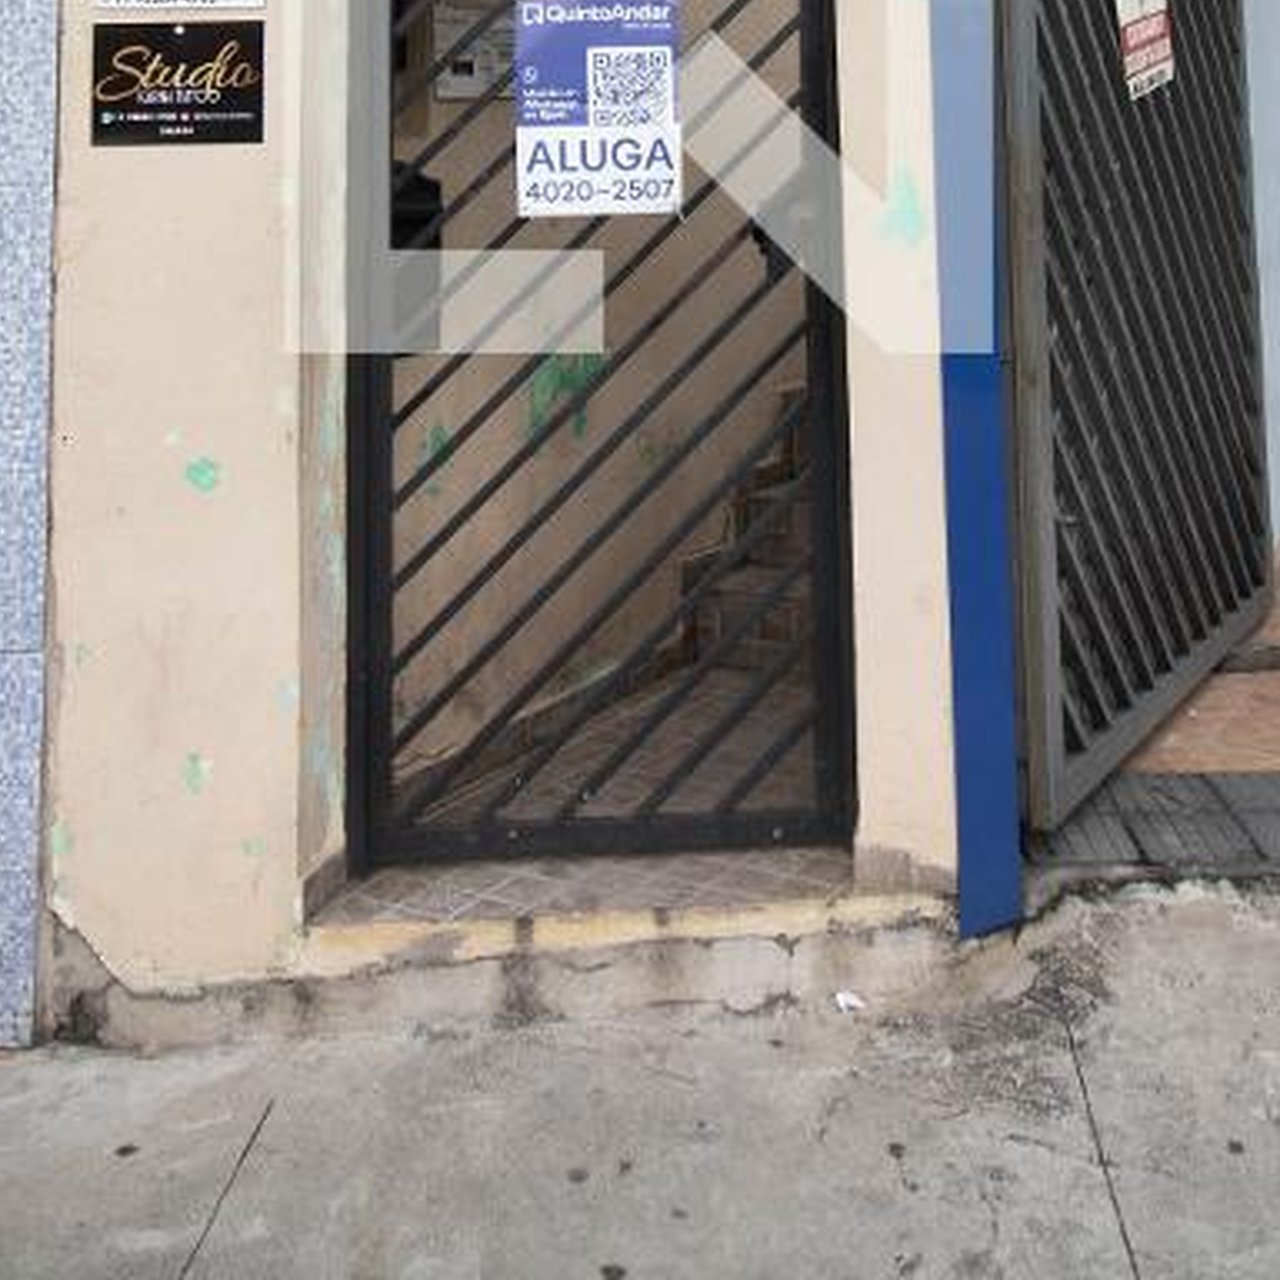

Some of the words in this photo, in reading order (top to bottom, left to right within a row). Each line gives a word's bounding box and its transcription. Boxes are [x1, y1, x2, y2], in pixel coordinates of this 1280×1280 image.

[546, 3, 670, 23] QuintoAndar
[95, 40, 260, 102] Studio
[526, 138, 674, 173] ALUGA
[525, 179, 675, 202] 4020-2507
